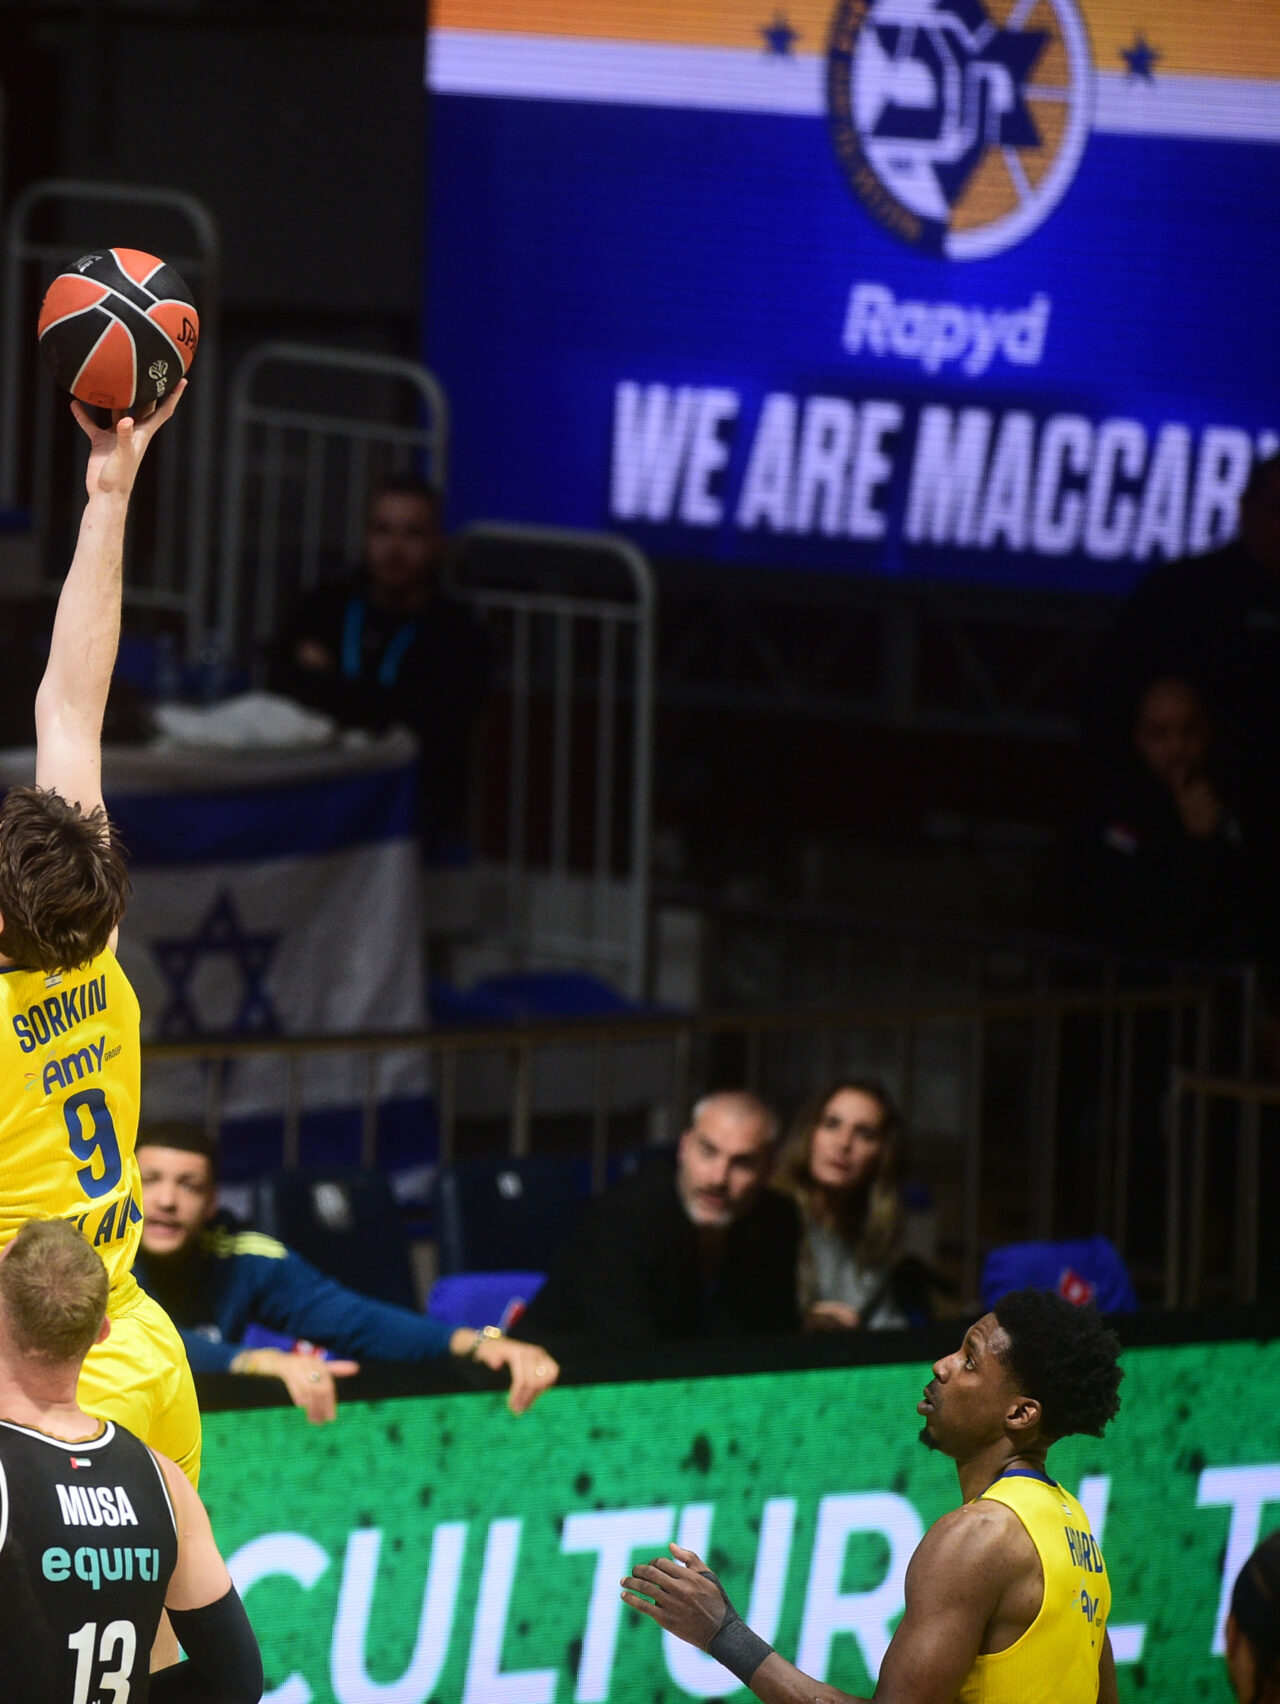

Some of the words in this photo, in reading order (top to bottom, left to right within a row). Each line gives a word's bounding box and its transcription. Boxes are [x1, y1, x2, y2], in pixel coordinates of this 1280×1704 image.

[843, 281, 1051, 377] Rapyd
[610, 380, 739, 524] WE
[735, 392, 903, 539] ARE
[904, 405, 1279, 562] MACCAB
[13, 973, 107, 1053] SORKIN
[63, 1088, 122, 1199] 9
[56, 1484, 139, 1526] MUSA
[42, 1547, 159, 1590] equiti
[68, 1620, 137, 1704] 13
